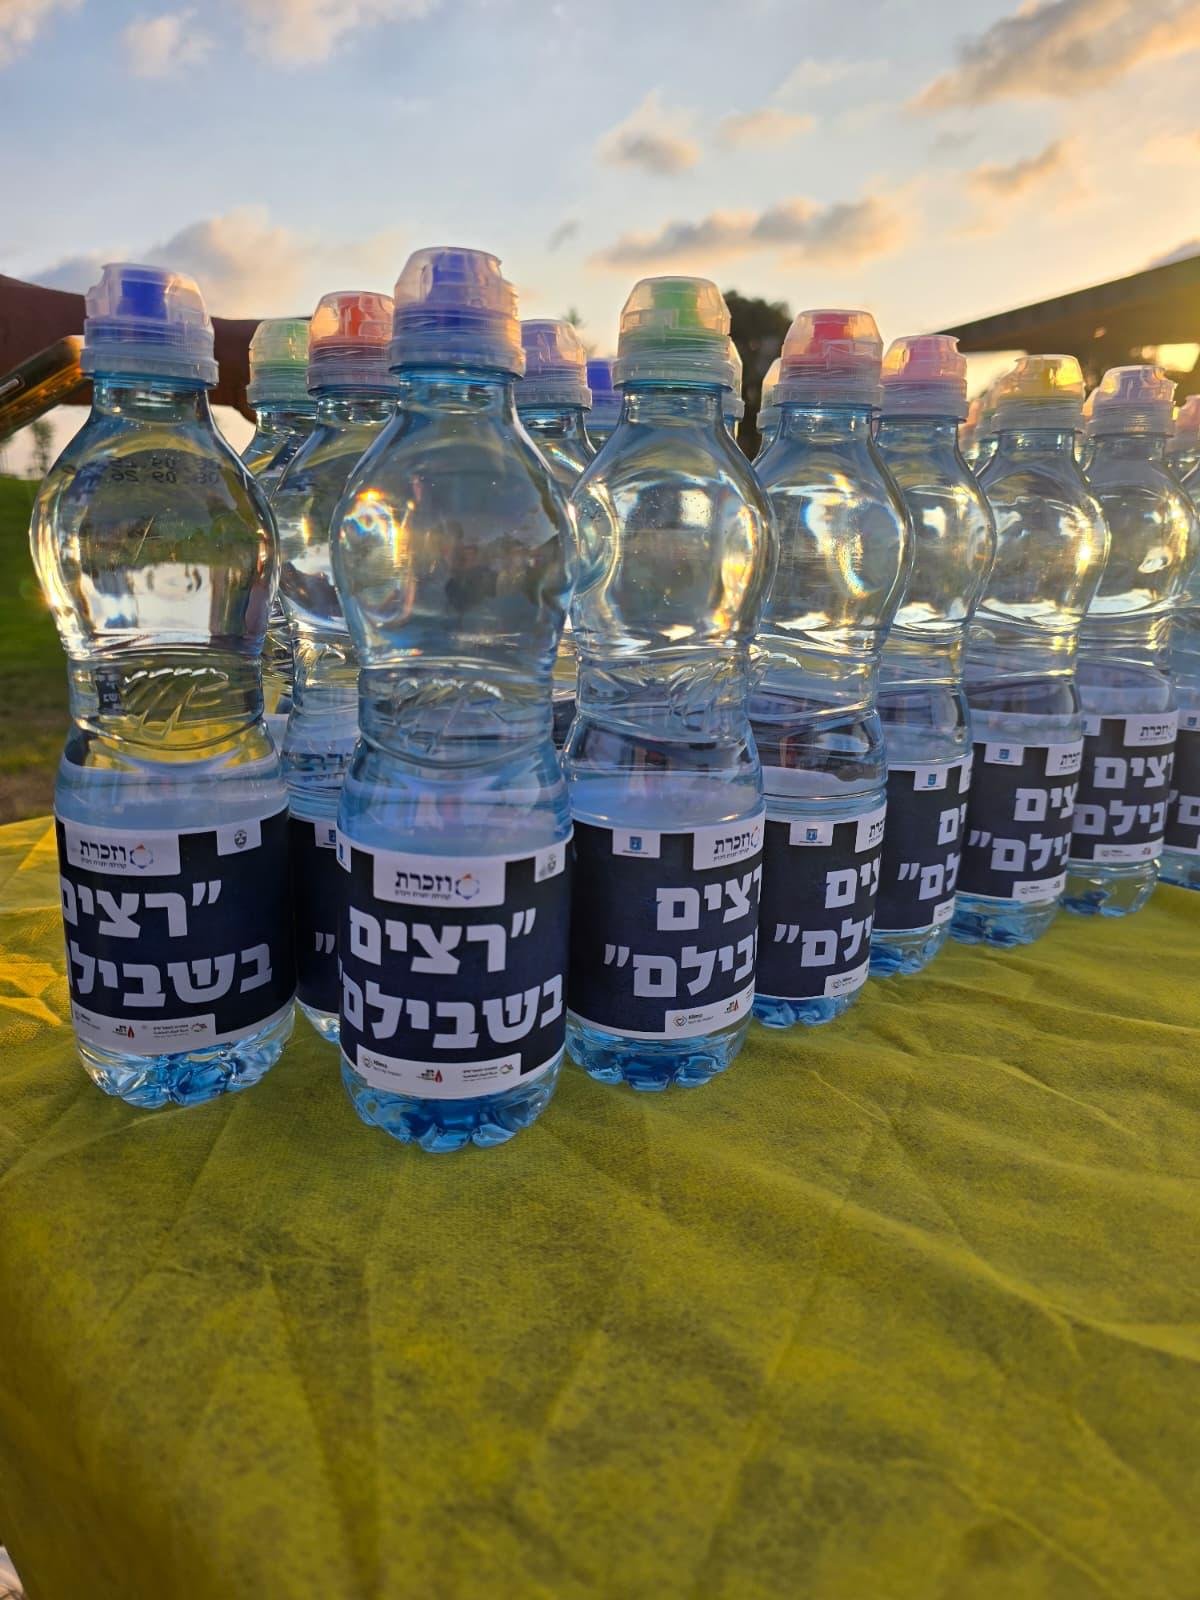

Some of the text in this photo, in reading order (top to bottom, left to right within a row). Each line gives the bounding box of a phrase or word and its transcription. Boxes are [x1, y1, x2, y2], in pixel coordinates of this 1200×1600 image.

[80, 839, 127, 861] וזכרת
[395, 871, 452, 892] וזכרת
[69, 939, 272, 1008] בשביל
[339, 974, 562, 1049] בשבילם
